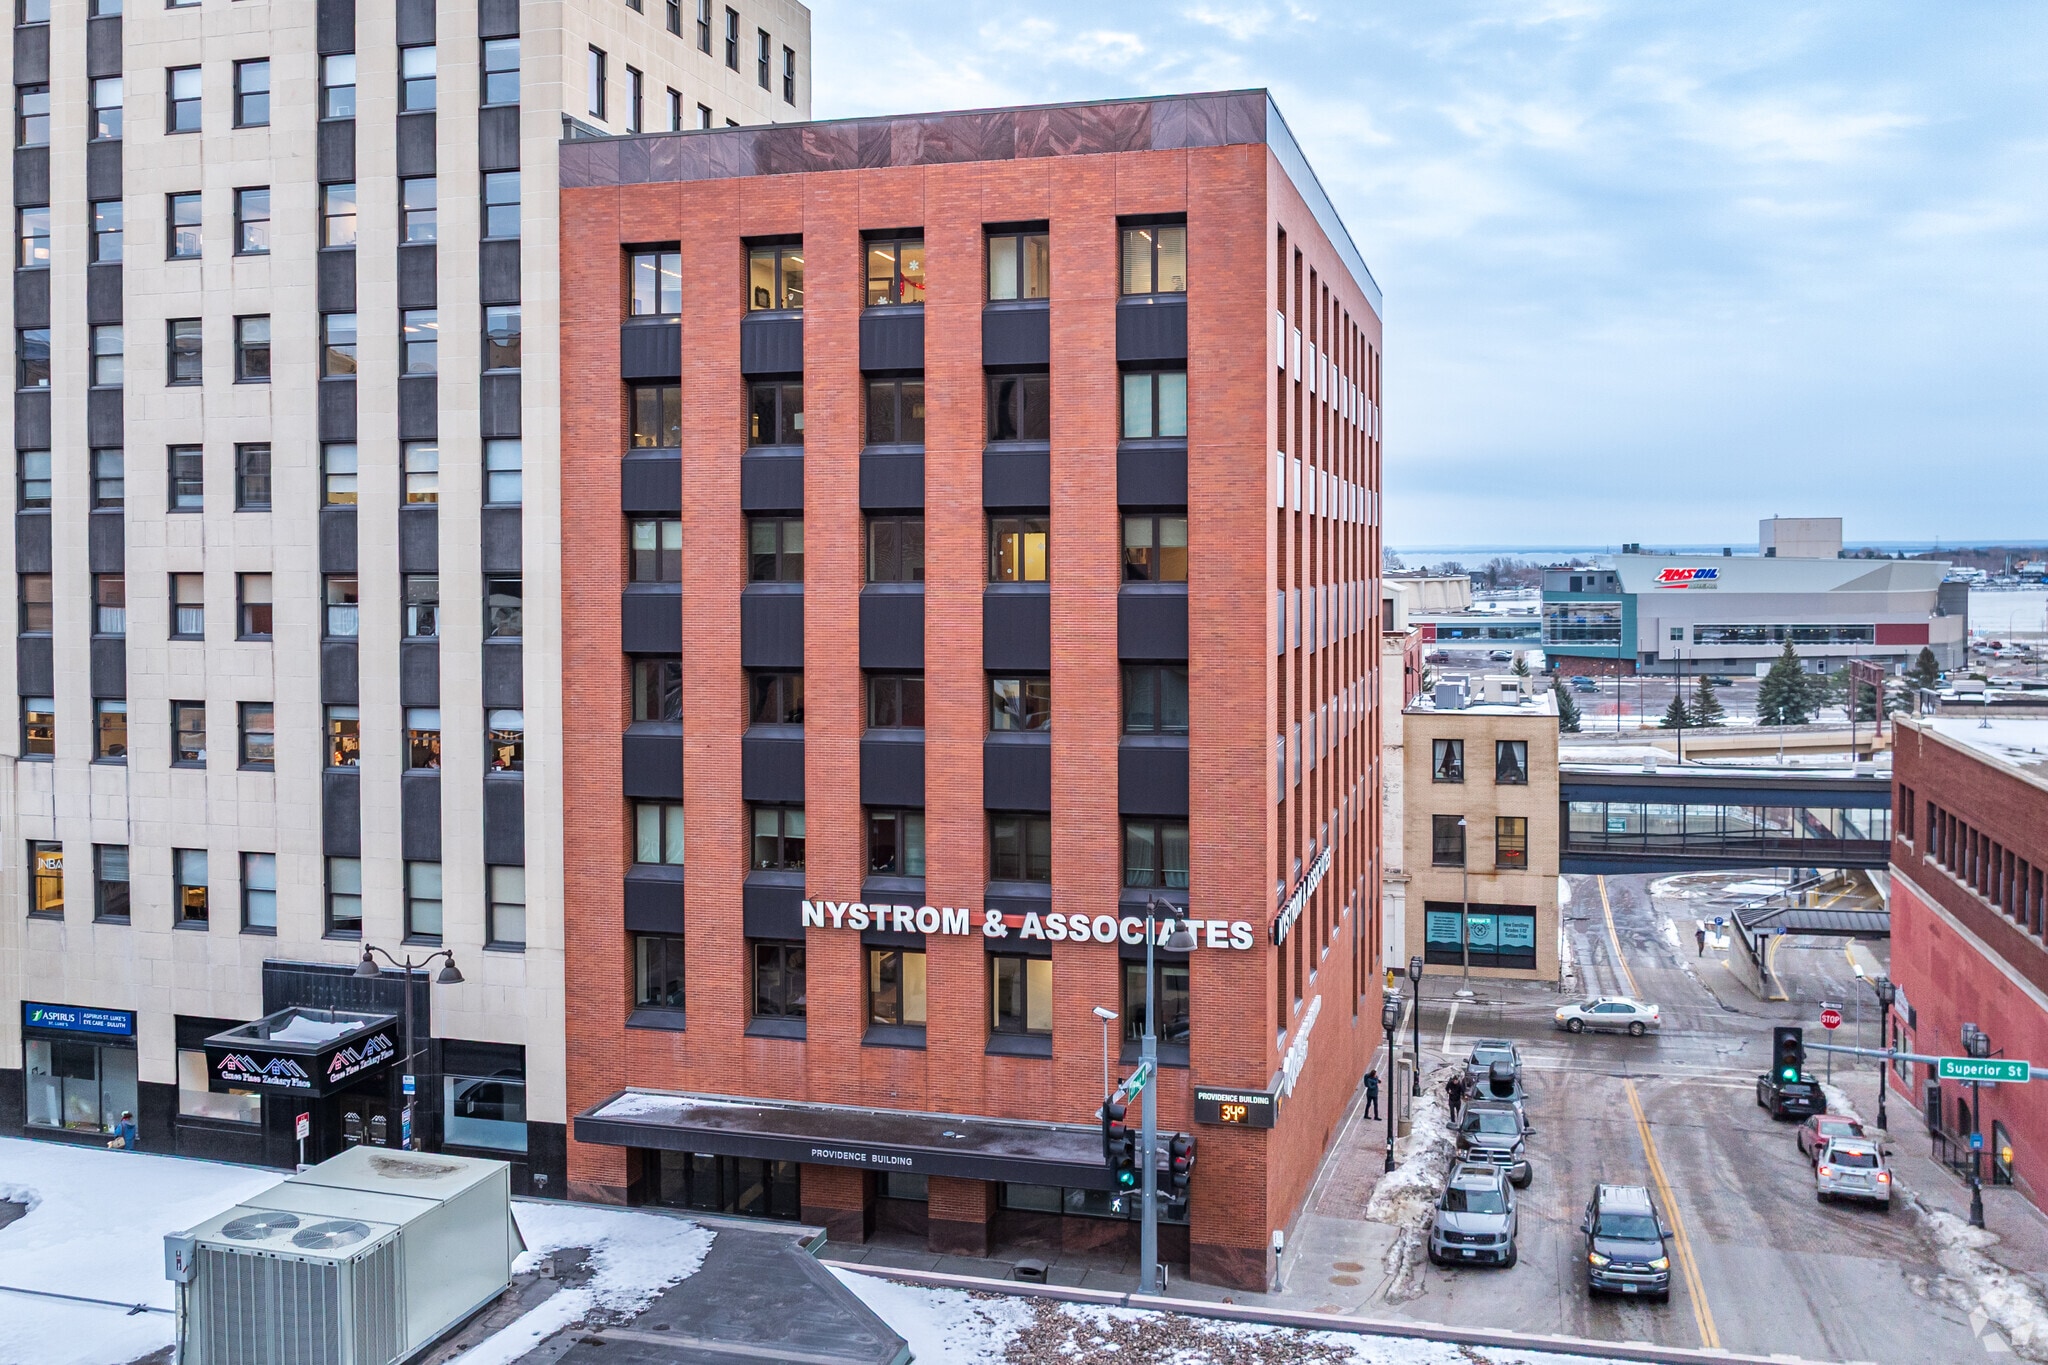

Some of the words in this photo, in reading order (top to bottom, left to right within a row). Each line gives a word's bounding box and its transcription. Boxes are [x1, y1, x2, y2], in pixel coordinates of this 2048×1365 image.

[1655, 568, 1719, 582] AMSOIL
[801, 900, 970, 936] NYSTROM
[982, 908, 1009, 939] &
[43, 1011, 75, 1022] ASPIRUS
[1821, 1014, 1840, 1024] STOP
[1946, 1062, 2001, 1076] Superior
[2008, 1065, 2022, 1077] St
[1198, 1092, 1238, 1102] PROVIDENCE
[1239, 1096, 1269, 1104] BUILDING
[811, 1148, 867, 1162] PROVIDENCE
[871, 1154, 913, 1166] BUILDING
